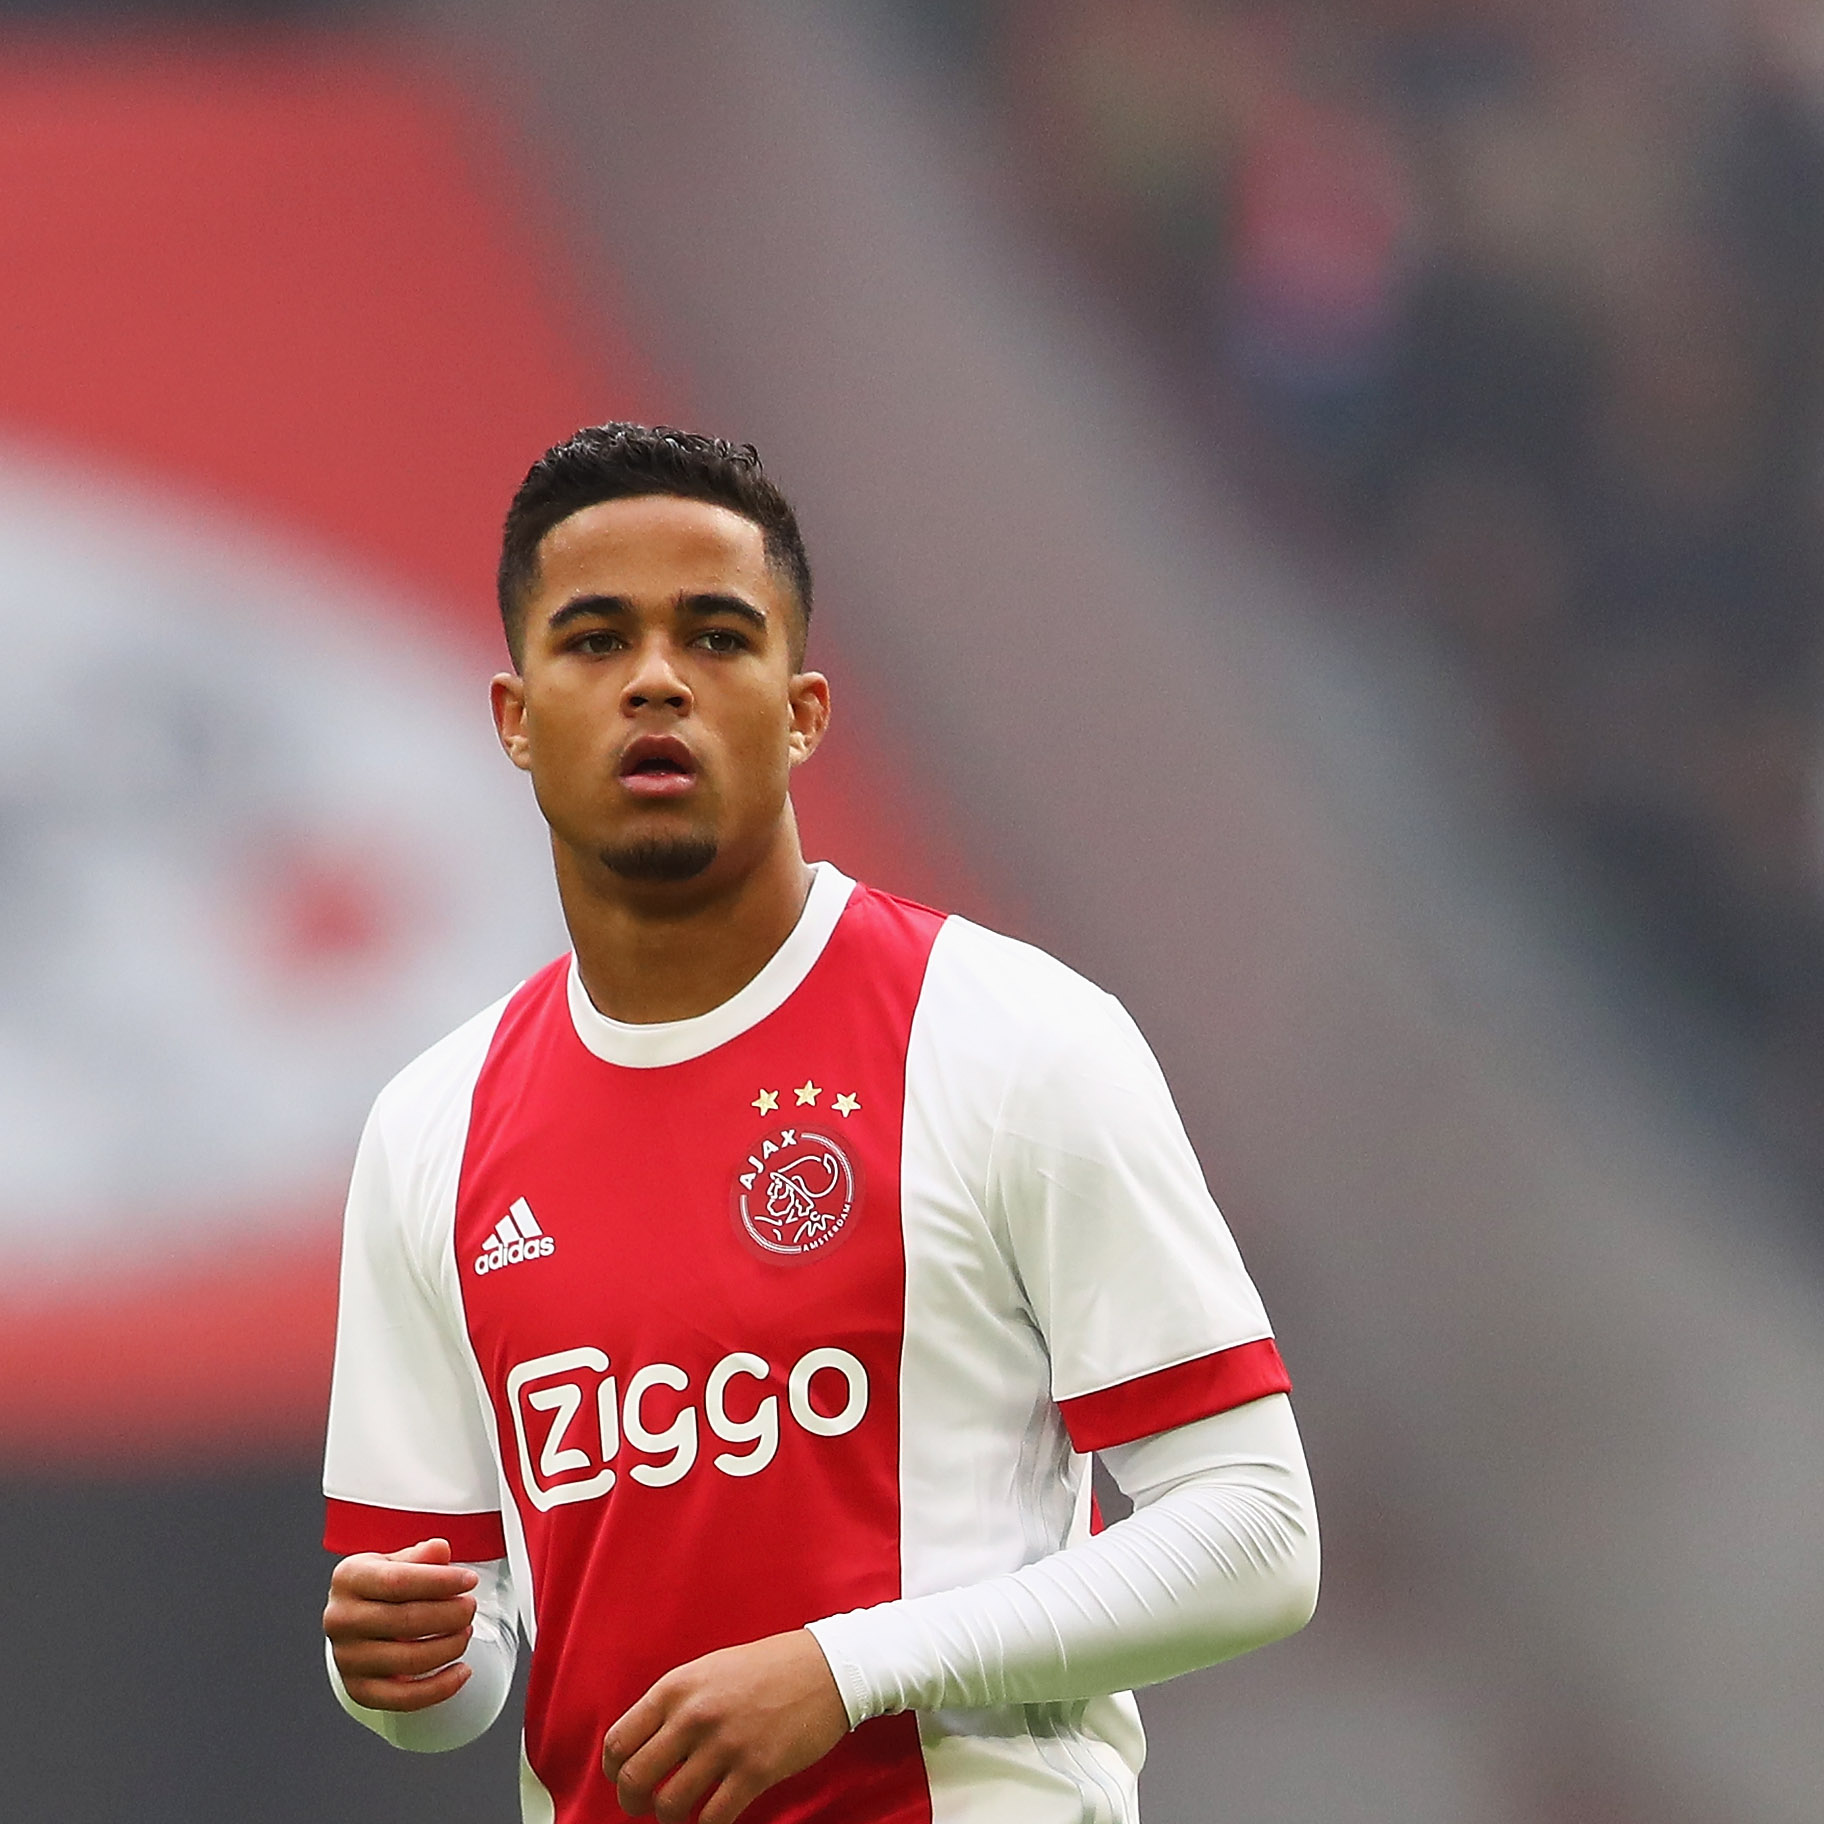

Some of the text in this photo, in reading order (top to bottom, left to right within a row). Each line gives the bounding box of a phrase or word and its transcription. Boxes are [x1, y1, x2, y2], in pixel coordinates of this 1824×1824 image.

[739, 1128, 798, 1191] AJAX
[801, 1203, 852, 1253] AMSTERDAM
[474, 1236, 555, 1275] adidas
